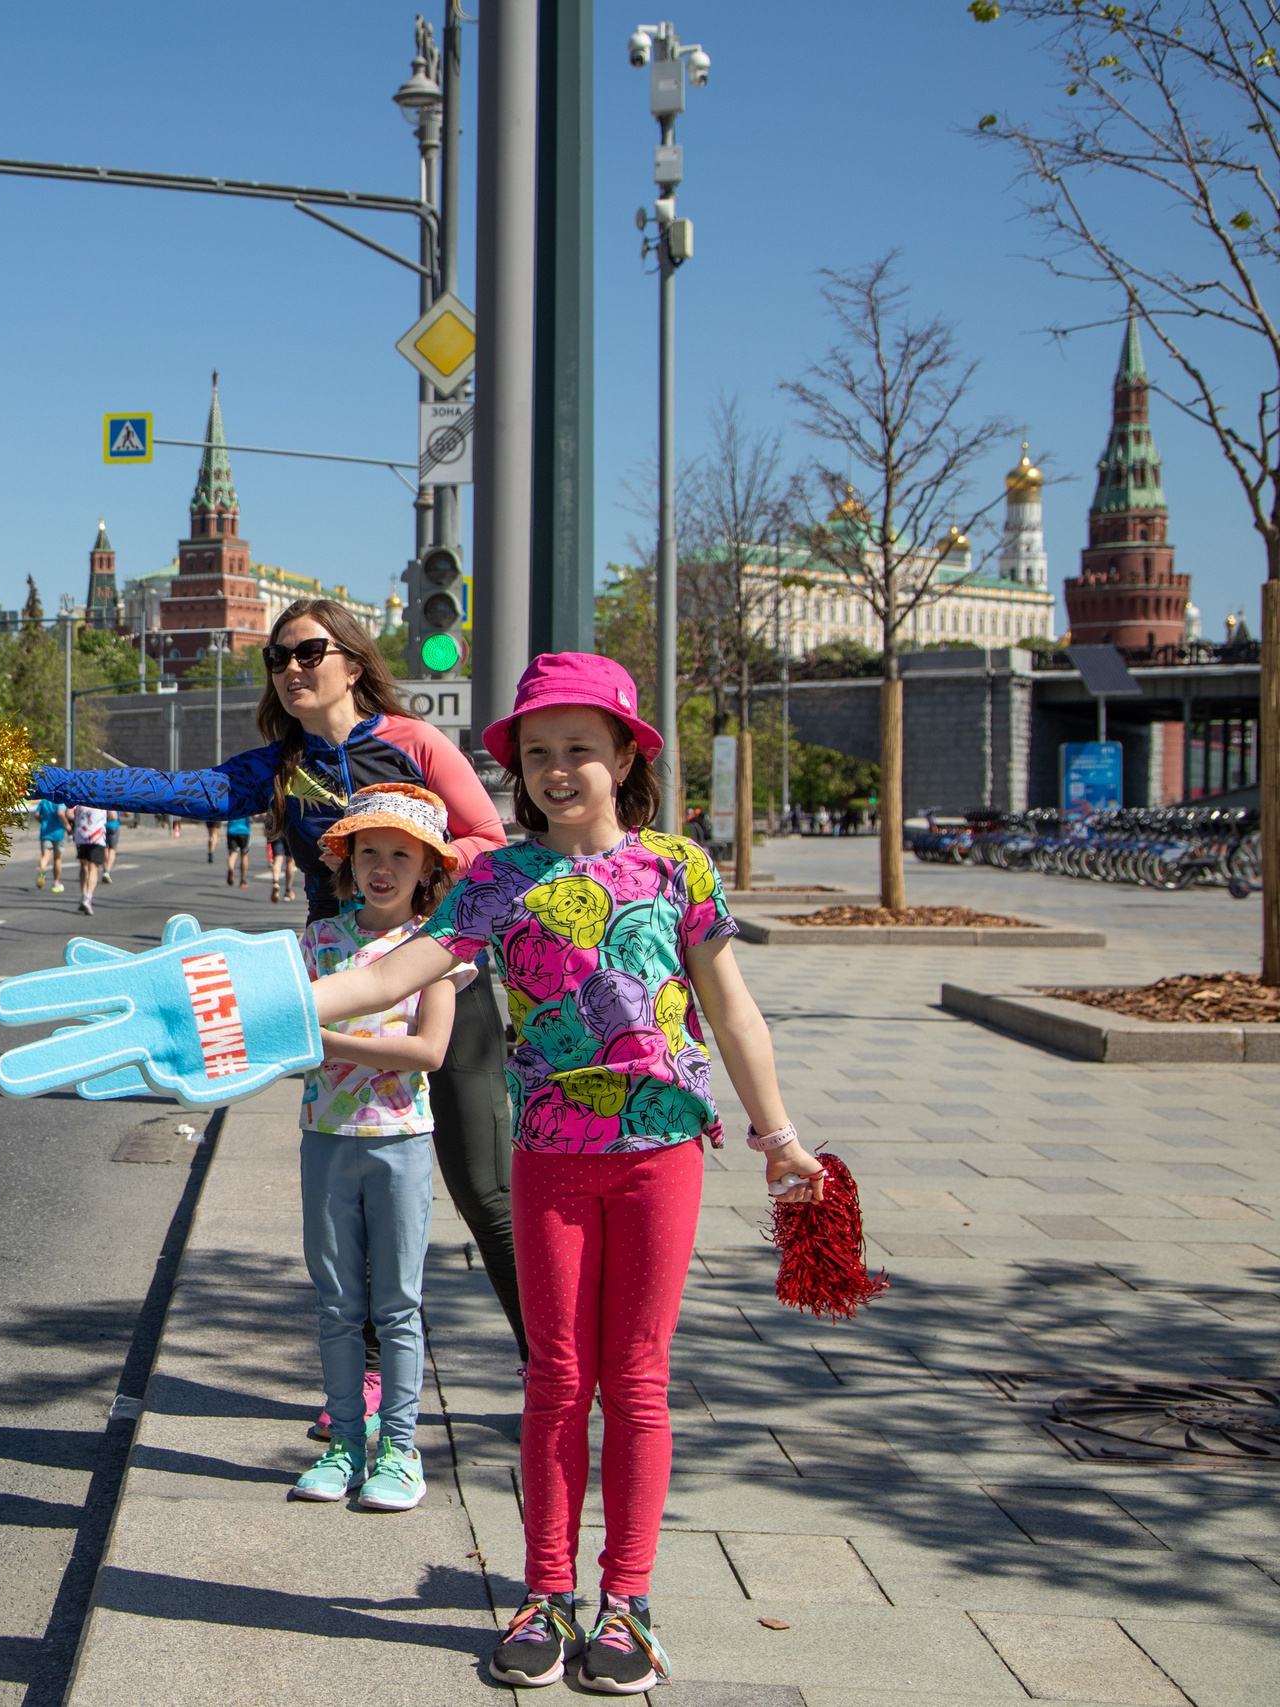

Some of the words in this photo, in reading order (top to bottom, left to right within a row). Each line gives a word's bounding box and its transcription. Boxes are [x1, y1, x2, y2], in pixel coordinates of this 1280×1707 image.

[432, 406, 463, 417] ЗОНА
[394, 692, 460, 716] ОП
[181, 952, 249, 1077] #МЕЧТА
